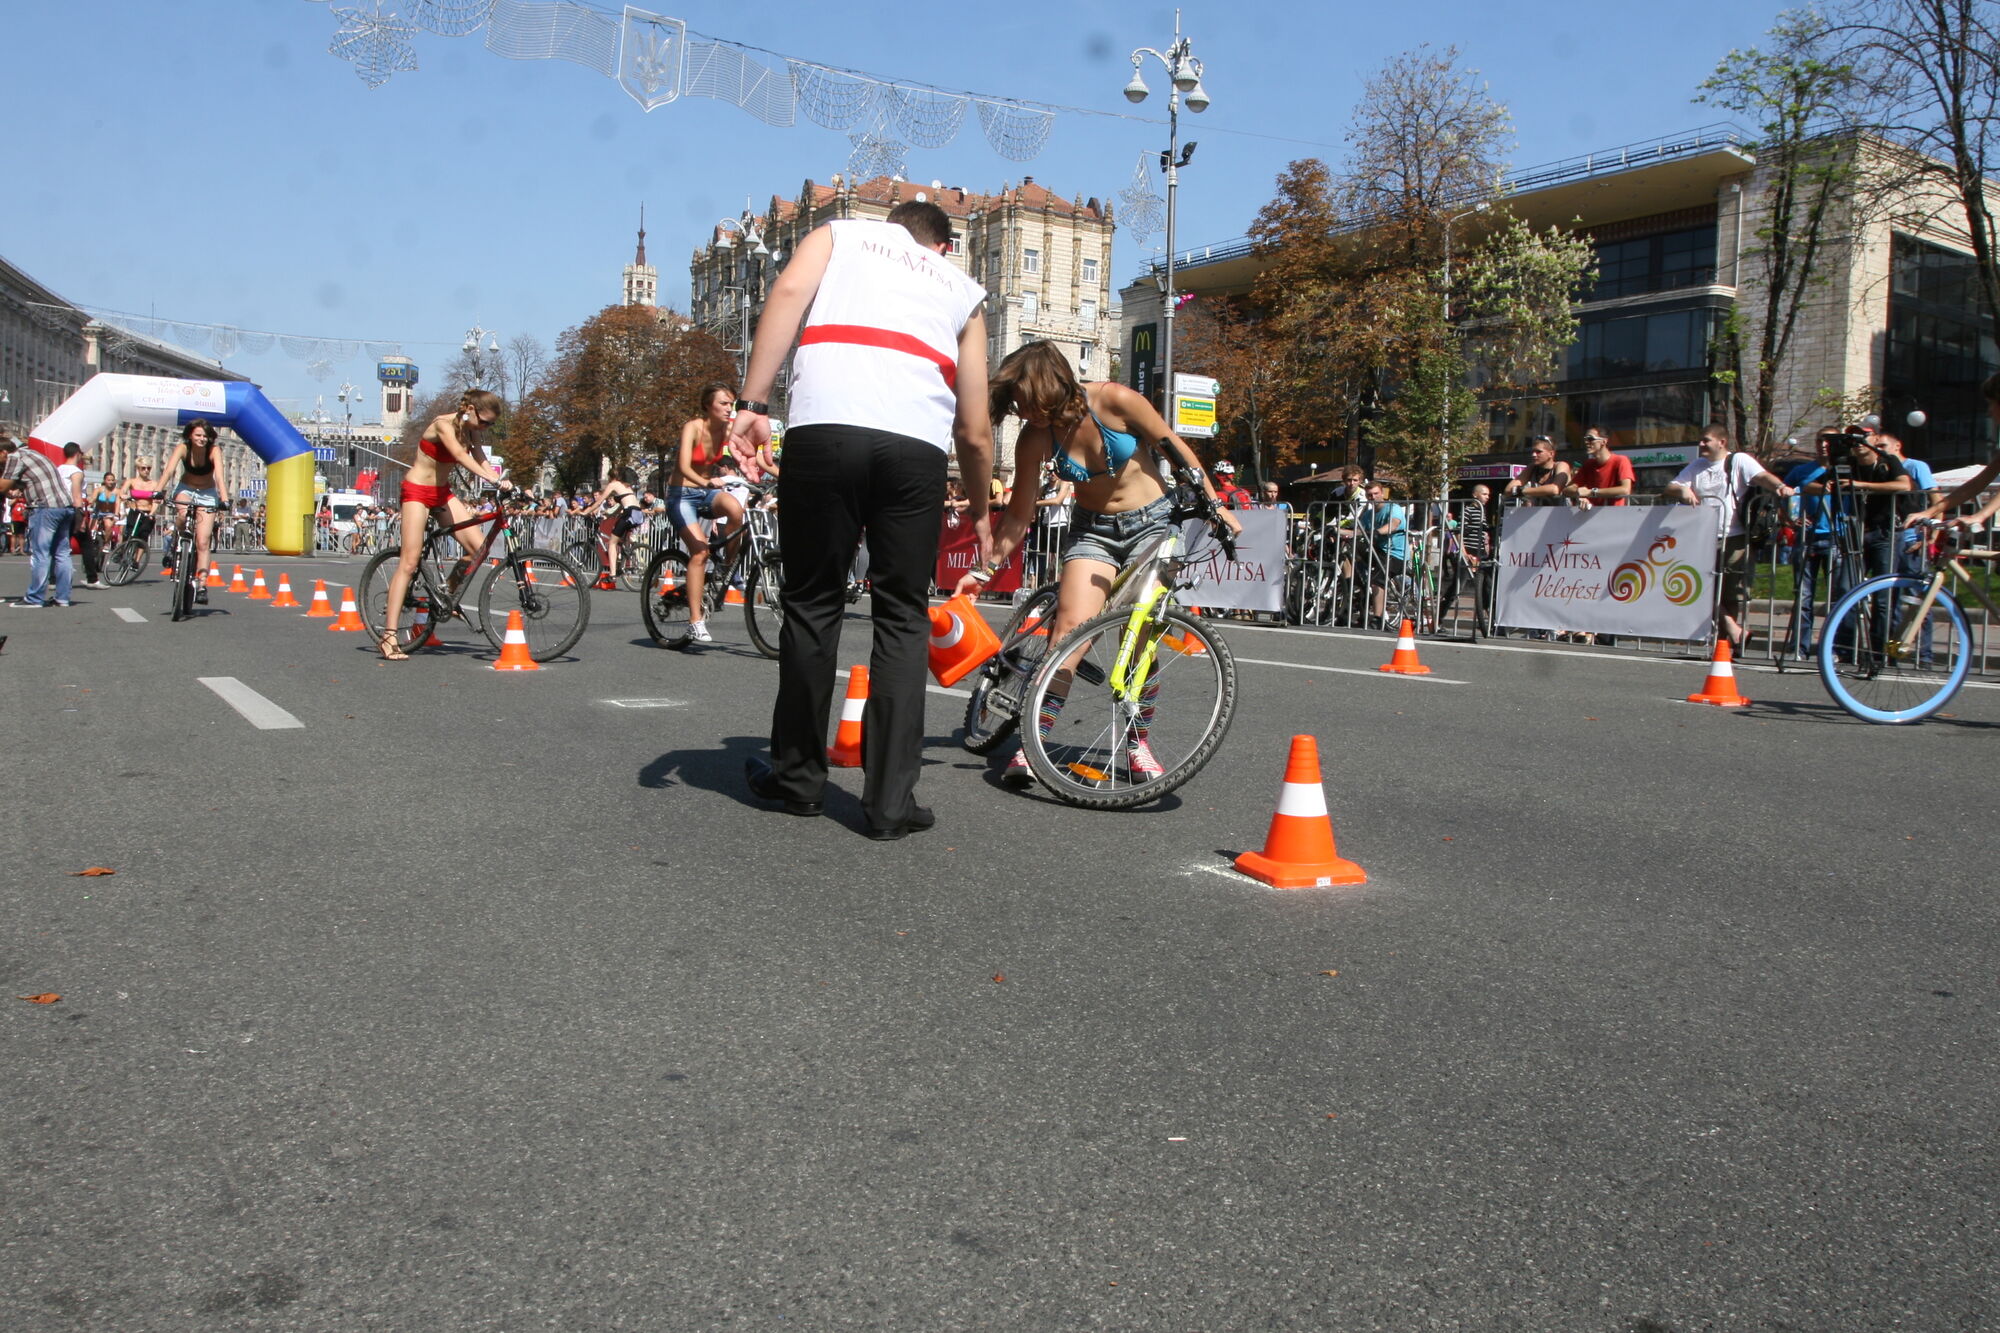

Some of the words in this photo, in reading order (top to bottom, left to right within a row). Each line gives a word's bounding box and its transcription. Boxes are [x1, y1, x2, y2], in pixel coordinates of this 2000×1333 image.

[1178, 549, 1266, 586] IAVITSA
[1508, 543, 1602, 573] MILAVITSA
[1532, 573, 1601, 606] Velofest
